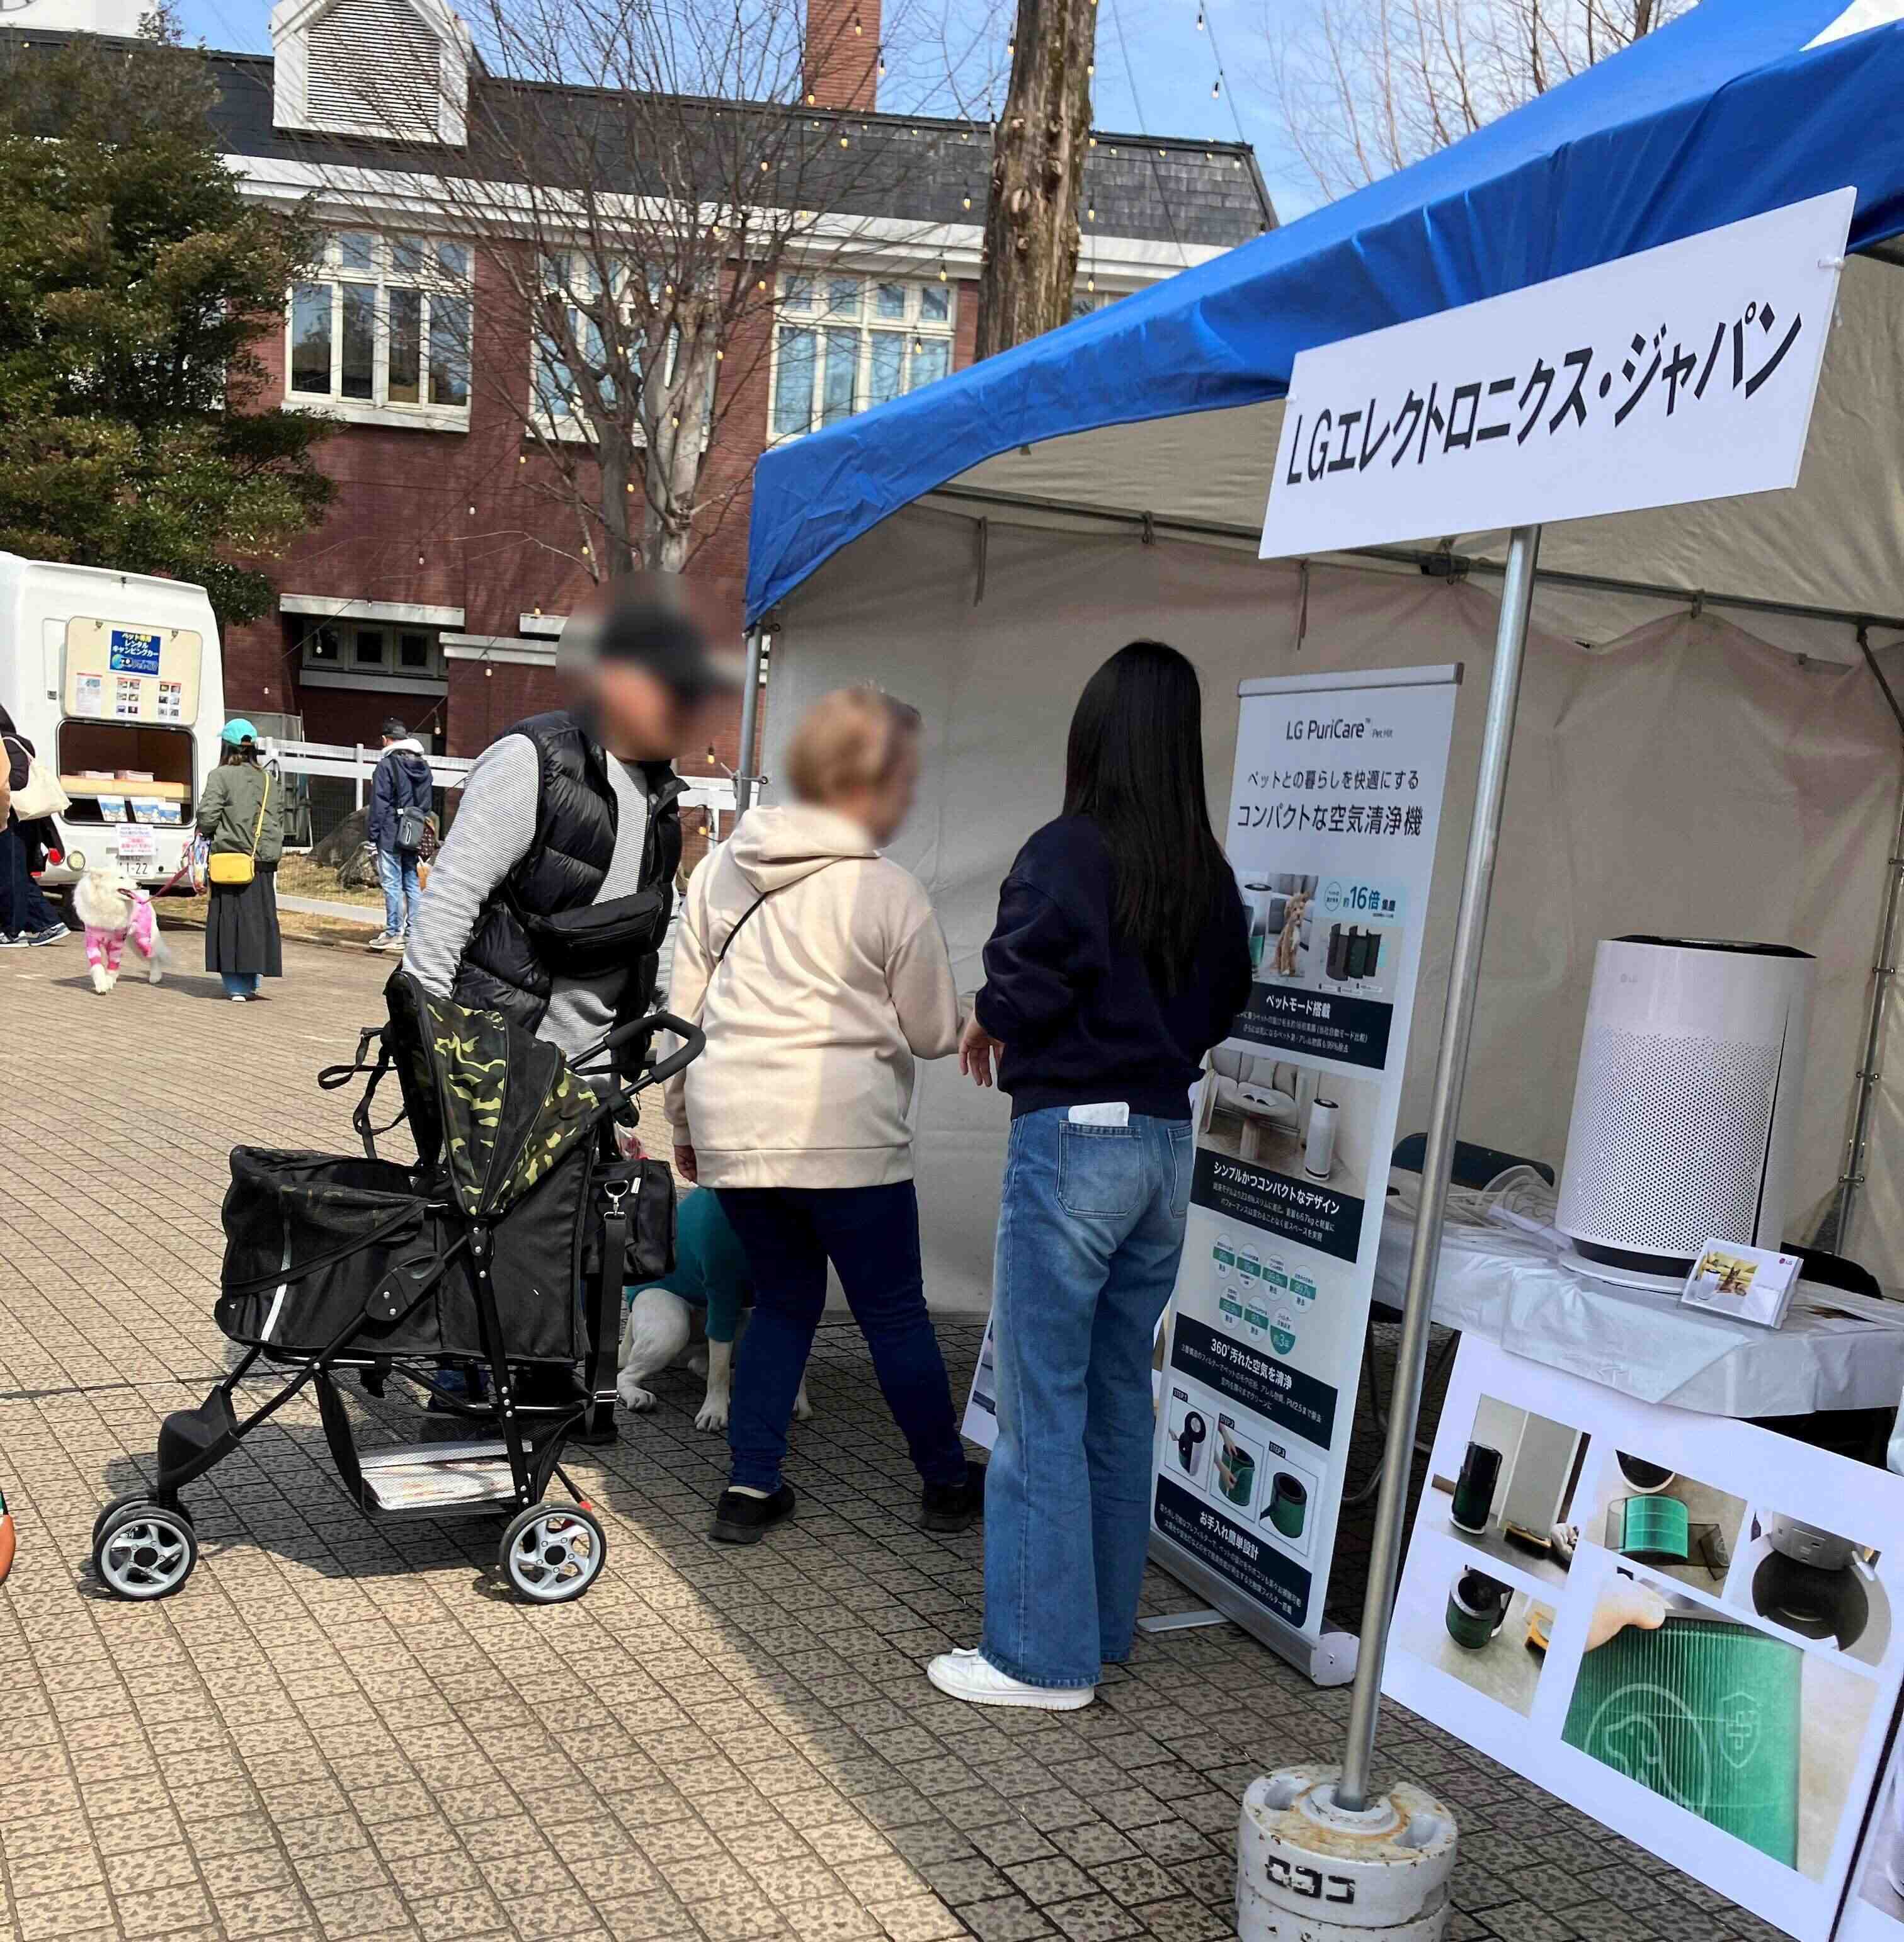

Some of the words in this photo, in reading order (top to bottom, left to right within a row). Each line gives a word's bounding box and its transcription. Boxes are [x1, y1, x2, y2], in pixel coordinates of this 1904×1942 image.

[1286, 300, 1803, 486] LGエレクトロニクス・ジャパン
[112, 645, 159, 657] キャンピングカー
[125, 640, 149, 649] レンタル
[1286, 720, 1303, 741] LG
[1308, 718, 1365, 741] PuriCare
[1248, 770, 1419, 790] ペットとの暮らしを快適にする
[1237, 802, 1423, 836] コンパクトな空気清浄機
[1266, 994, 1331, 1019] ペットモード搭載
[1214, 1162, 1340, 1215] シンプルかつコンパクトなデザイン
